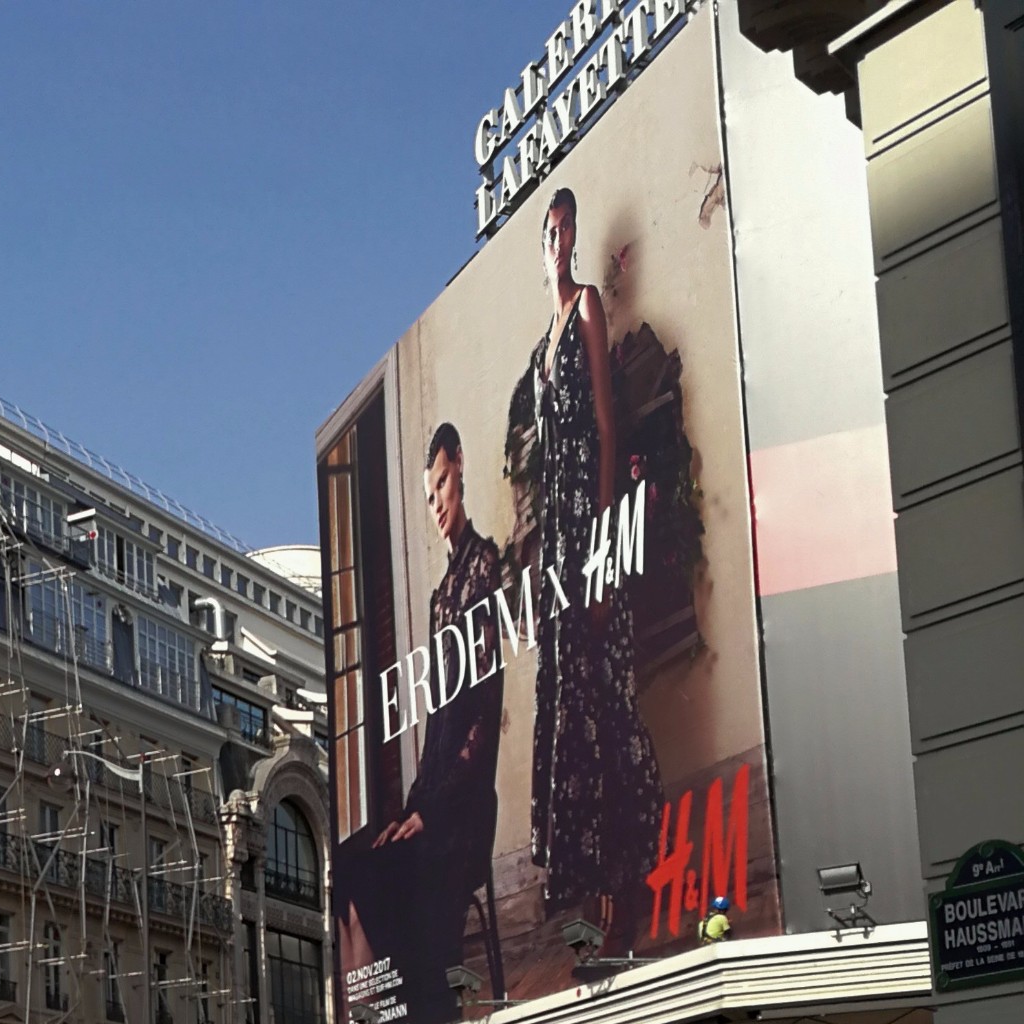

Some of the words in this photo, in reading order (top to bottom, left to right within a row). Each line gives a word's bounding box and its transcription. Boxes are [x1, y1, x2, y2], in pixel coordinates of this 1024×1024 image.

[475, 0, 621, 167] GALERI
[476, 0, 685, 237] LAFAYETTE
[379, 565, 538, 744] ERDEM
[581, 479, 646, 609] H&M
[645, 763, 750, 940] H&M
[944, 888, 1024, 924] BOULEVAR
[944, 916, 1024, 950] HAUSSMA
